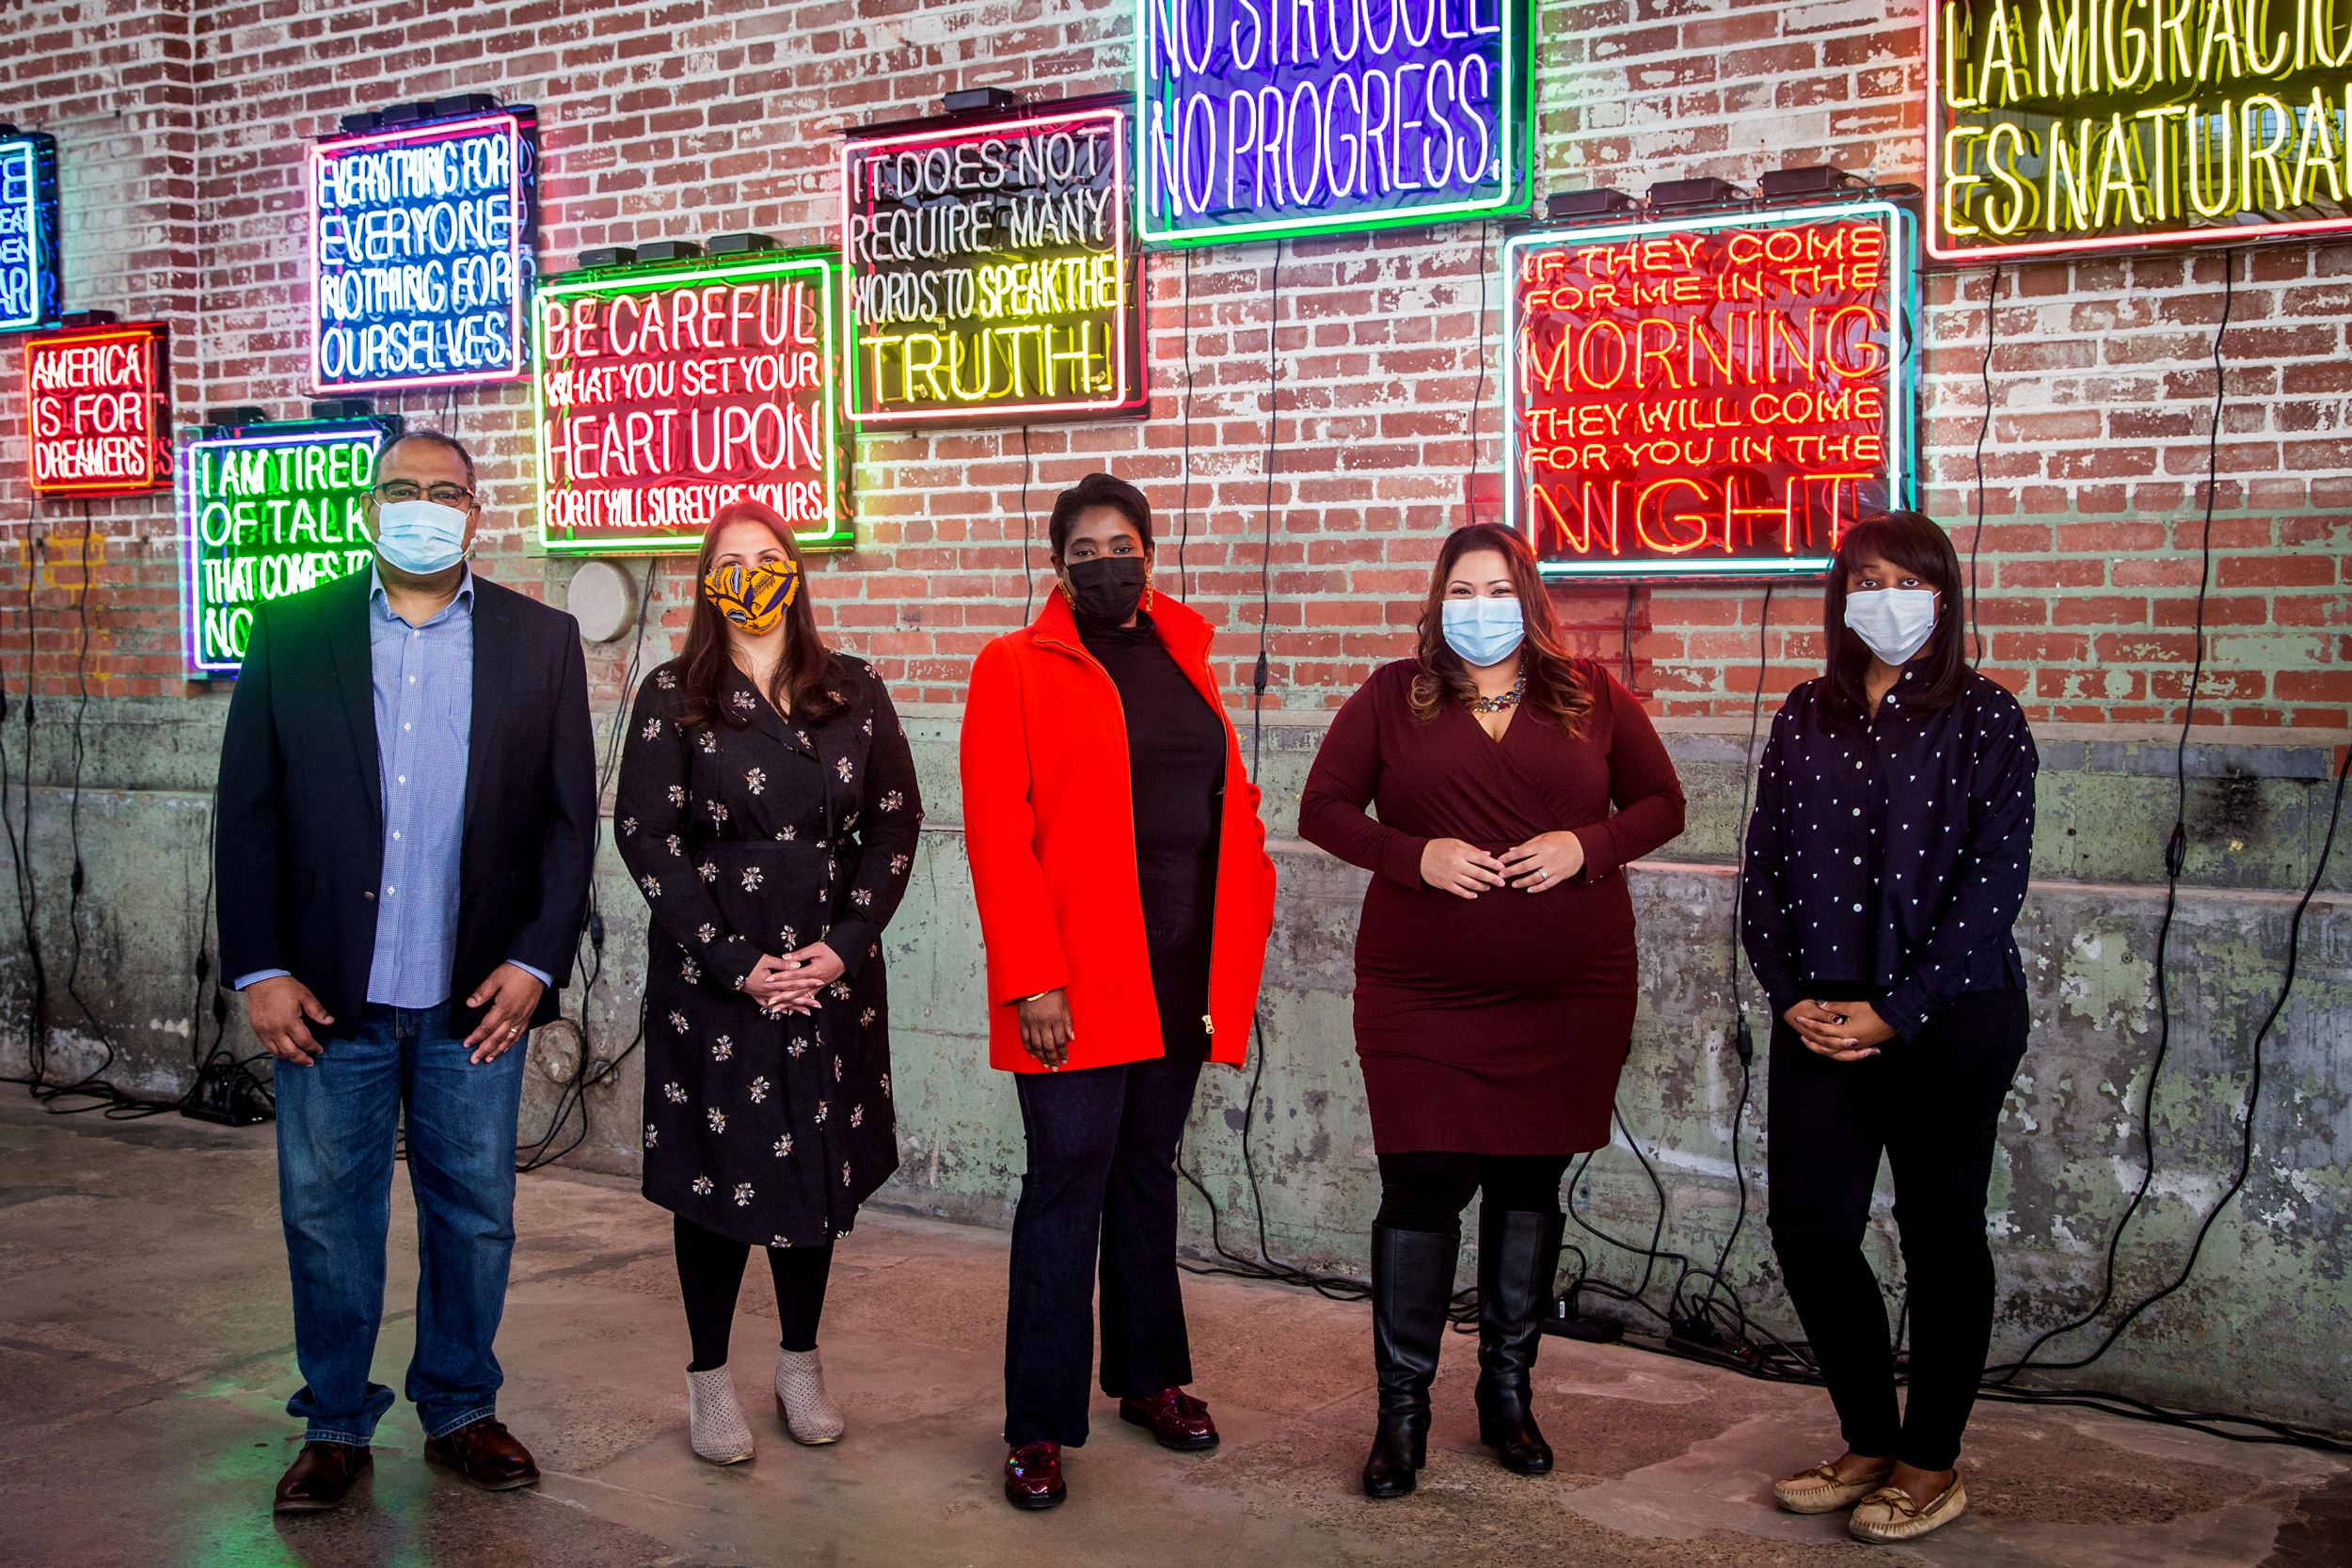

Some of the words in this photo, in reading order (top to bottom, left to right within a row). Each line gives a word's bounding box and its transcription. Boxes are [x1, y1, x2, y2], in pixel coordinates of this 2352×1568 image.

[1150, 0, 1215, 80] NO
[1945, 0, 2020, 109] LA
[853, 154, 890, 204] IT
[897, 139, 1008, 198] DOES
[1018, 126, 1111, 185] NOT
[1150, 92, 1216, 217] NO
[1227, 54, 1501, 209] PROGRESS.
[1944, 122, 2025, 236] ES
[2047, 82, 2352, 233] NATURA
[318, 141, 459, 209] EVERYTHING
[463, 134, 510, 190] FOR
[320, 195, 514, 265] EVERYONE
[850, 200, 993, 264] REQUIRE
[1010, 185, 1111, 249] MANY
[1522, 251, 1565, 283] IF
[1578, 236, 1705, 278] THEY
[1728, 227, 1882, 264] COME
[320, 260, 445, 321] NOTHING
[453, 250, 512, 306] FOR
[544, 297, 600, 359] BE
[610, 280, 818, 356] CAREFUL
[850, 269, 939, 326] WORDS
[945, 268, 974, 320] TO
[978, 258, 1063, 318] SPEAK
[1063, 255, 1117, 312] THE
[1525, 281, 1621, 315] FOR
[1632, 276, 1702, 307] ME
[1717, 271, 1764, 300] IN
[1779, 261, 1879, 296] THE
[31, 343, 143, 390] AMERICA
[321, 310, 513, 378] OURSELVES.
[544, 365, 619, 407] WHAT
[619, 360, 675, 398] YOU
[681, 357, 737, 396] SET
[740, 351, 820, 393] YOUR
[1521, 305, 1880, 395] MORNING
[32, 396, 61, 437] IS
[74, 391, 144, 435] FOR
[544, 409, 677, 483] HEART
[691, 400, 822, 475] UPON
[1524, 402, 1629, 442] THEY
[1638, 396, 1741, 434] WILL
[1750, 387, 1881, 424] COME
[34, 436, 146, 481] DREAMERS
[202, 451, 211, 499] I
[219, 448, 269, 497] AM
[275, 442, 373, 492] TIRED
[1523, 442, 1610, 474] FOR
[1624, 436, 1713, 467] YOU
[1730, 435, 1774, 464] IN
[1787, 434, 1881, 464] THE
[200, 501, 258, 546] OF
[266, 497, 373, 544] TALK
[545, 488, 586, 528] FOR
[585, 488, 605, 527] IT
[604, 488, 648, 528] WILL
[647, 483, 719, 527] SURELY
[1527, 472, 1875, 556] NIGHT
[202, 556, 258, 604] THAT
[260, 550, 340, 600] COMES
